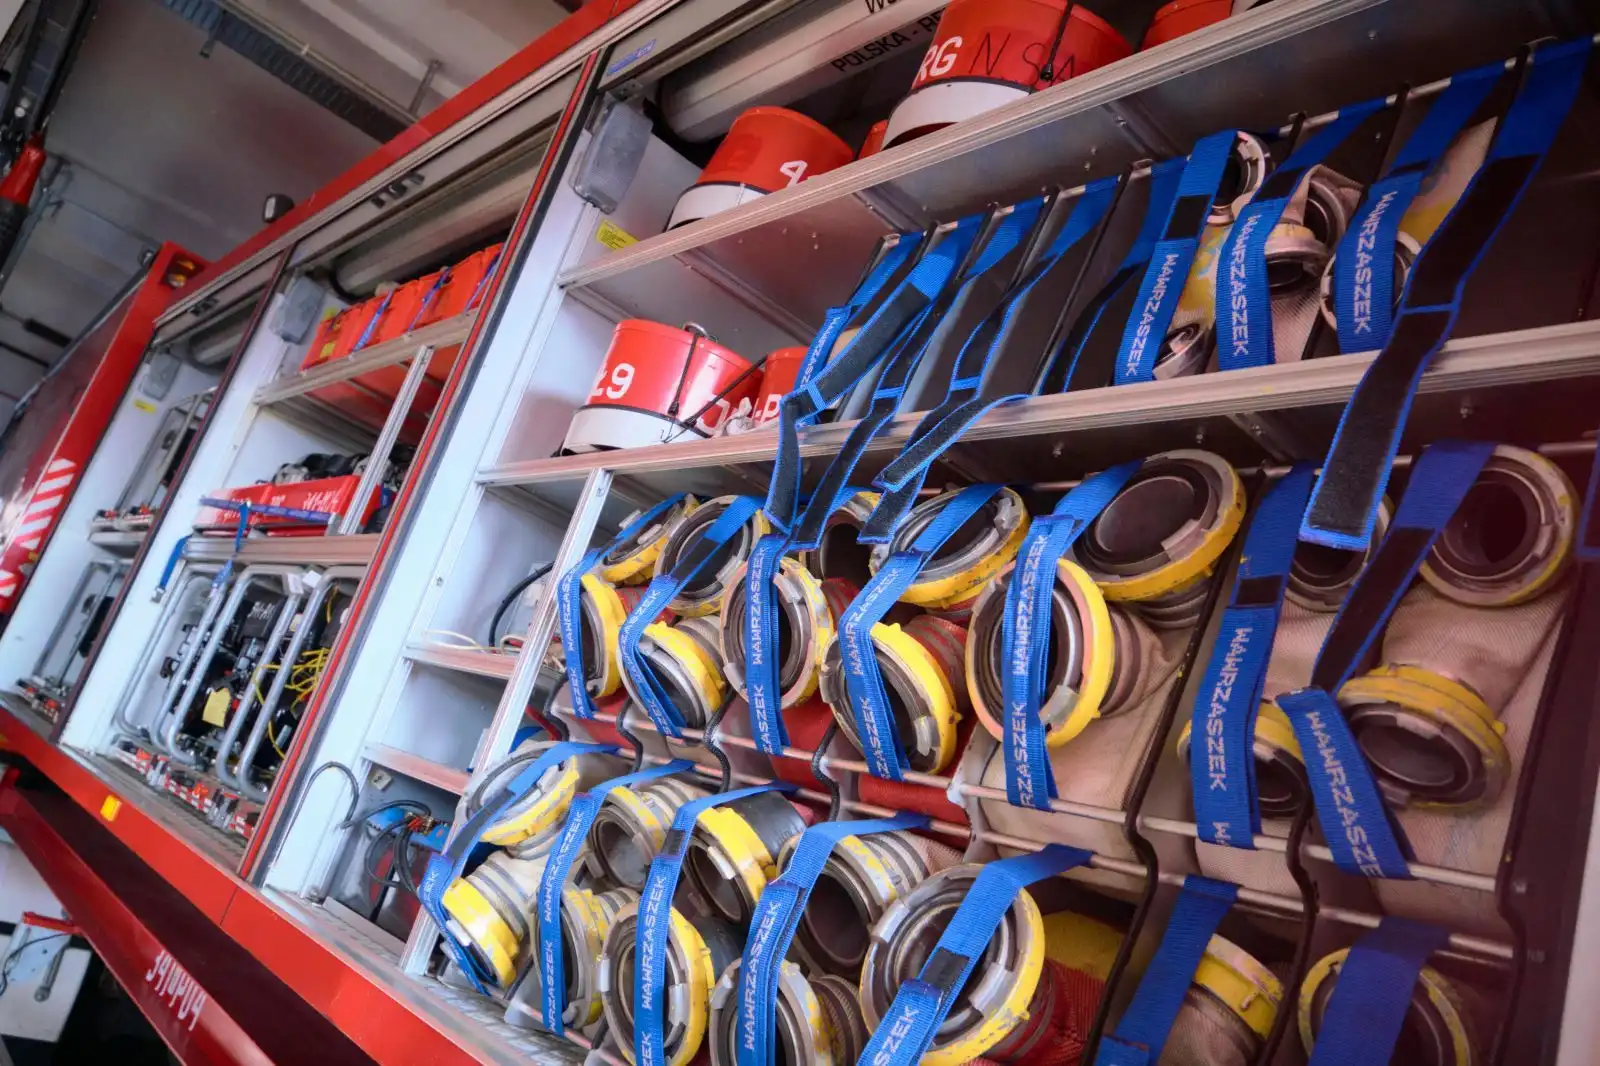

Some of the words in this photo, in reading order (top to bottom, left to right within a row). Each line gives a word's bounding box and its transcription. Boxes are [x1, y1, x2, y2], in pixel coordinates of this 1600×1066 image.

[830, 31, 911, 72] POLSKA
[1126, 253, 1180, 377] WAWRZASZEK
[1230, 214, 1261, 356] WAWRZASZEK
[1354, 190, 1398, 334] WAWRZASZEK
[1012, 534, 1051, 676] WAWRZASZEK
[1205, 627, 1253, 793] WAWRZASZEK
[641, 875, 668, 1011] WAWRZASZEK
[743, 900, 783, 1051] WAWRZASZEK
